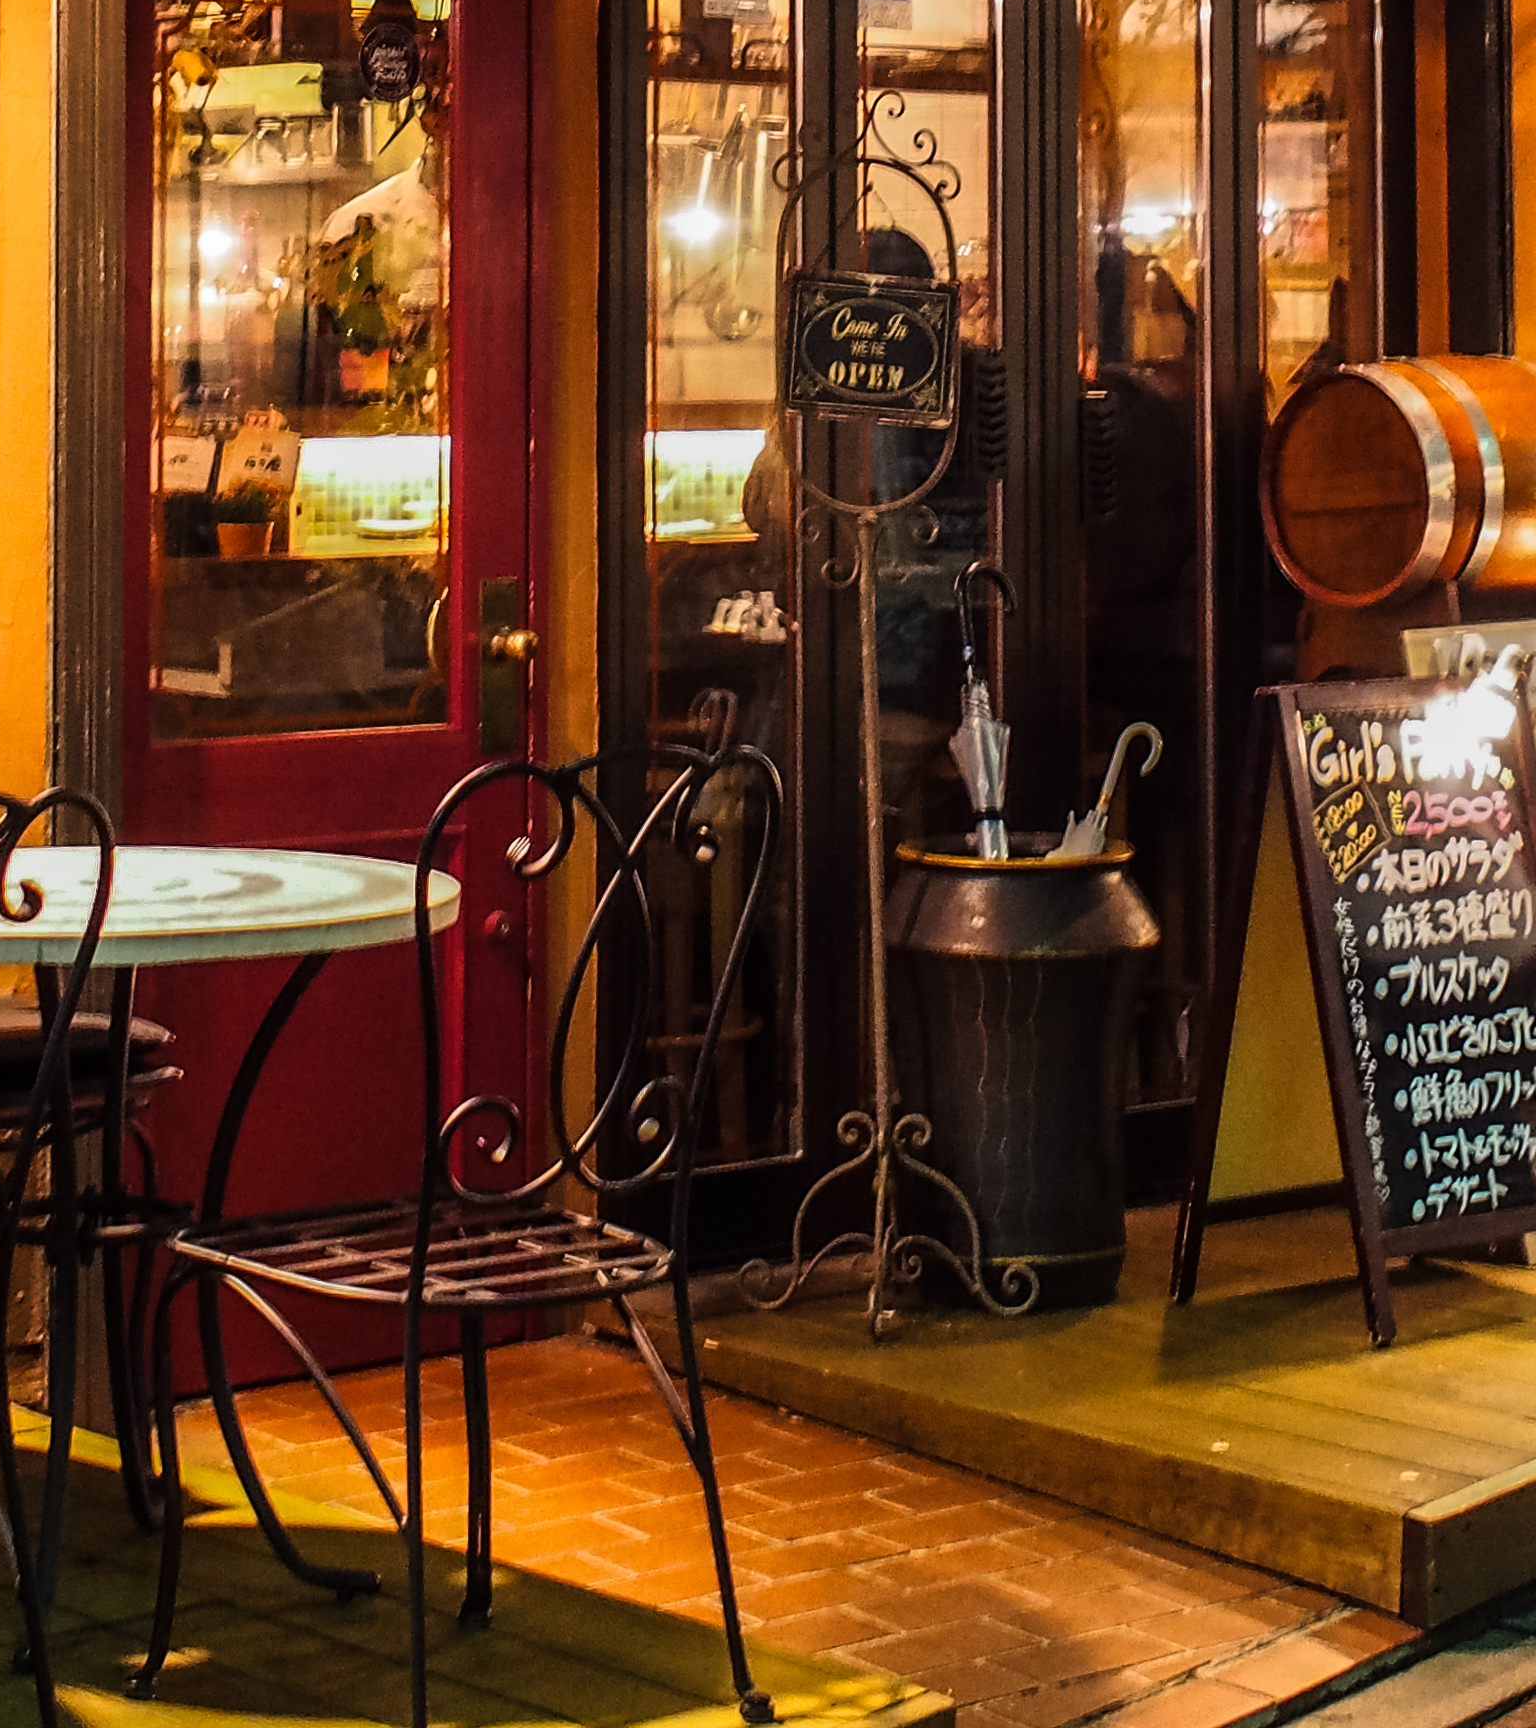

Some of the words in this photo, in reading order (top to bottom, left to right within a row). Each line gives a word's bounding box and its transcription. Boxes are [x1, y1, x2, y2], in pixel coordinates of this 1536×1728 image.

[831, 307, 879, 341] Come
[883, 313, 909, 341] In
[828, 360, 905, 391] OPEN
[1310, 720, 1396, 788] Girl's
[1372, 830, 1524, 895] 本日のサラダ
[1381, 888, 1533, 950] 前菜3種盛り
[1426, 1168, 1508, 1219] デザート
